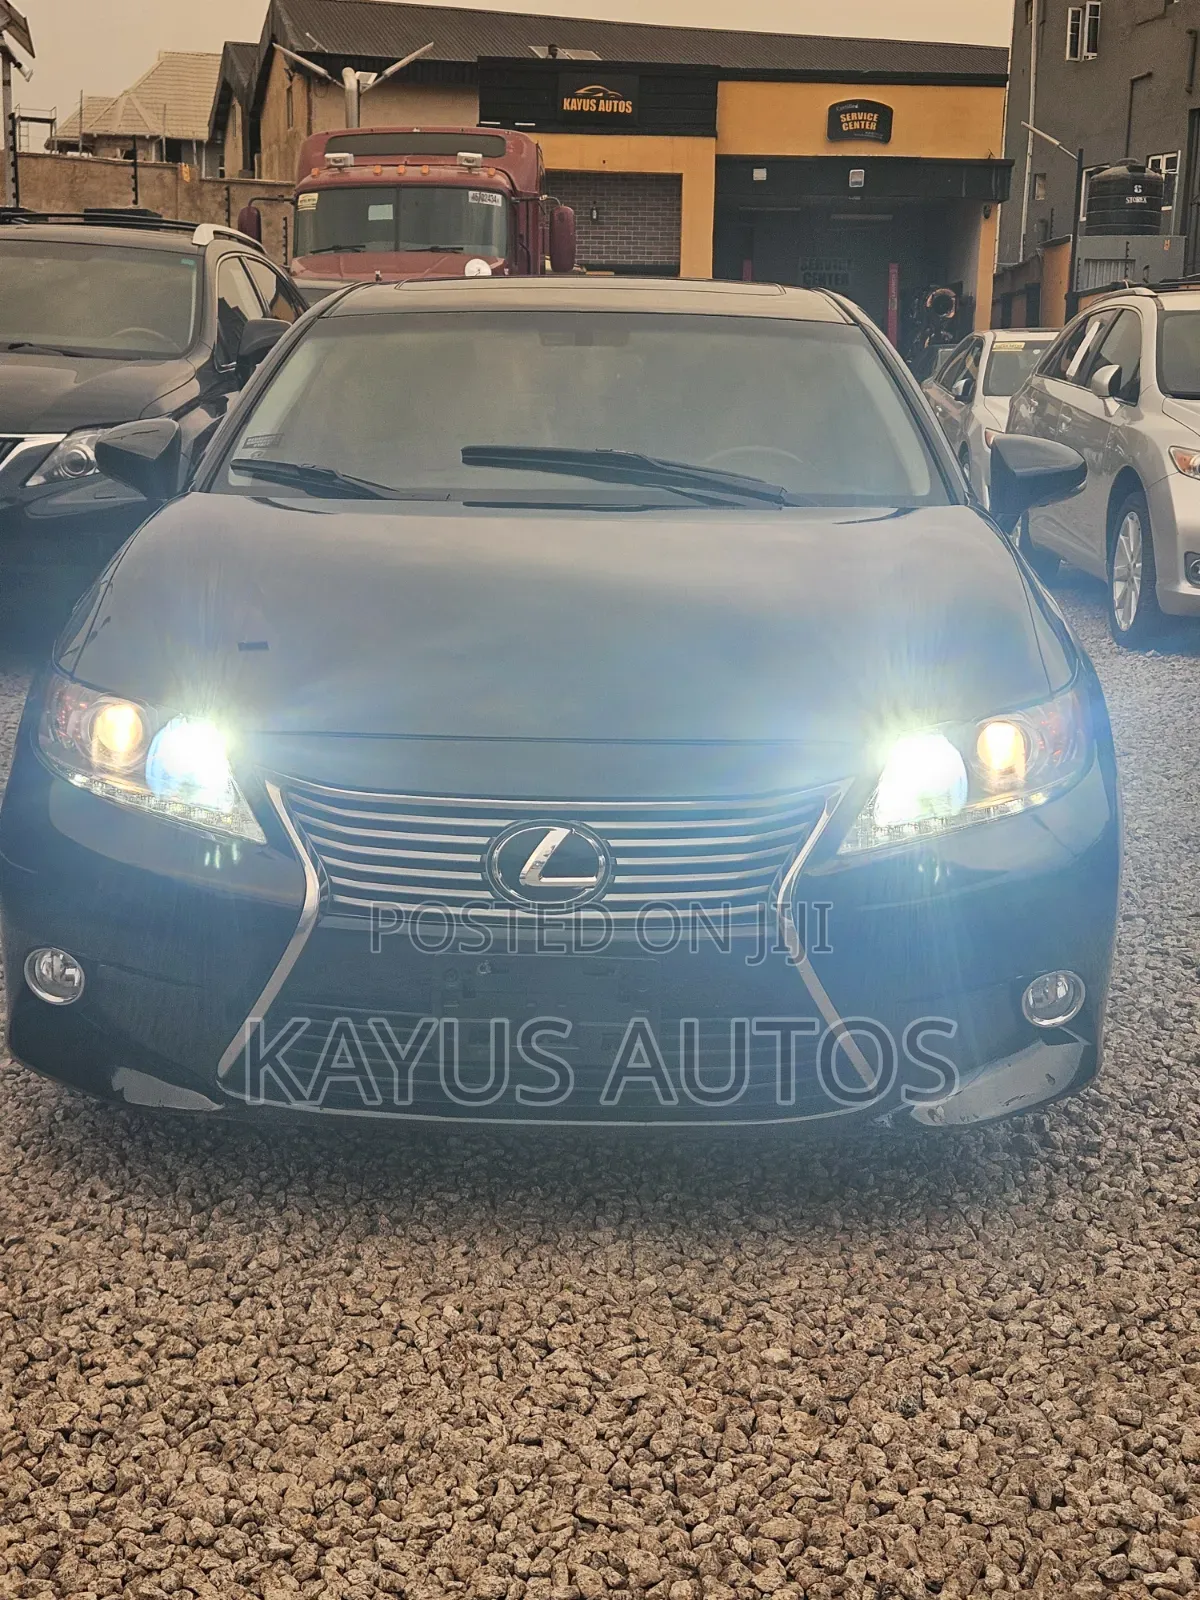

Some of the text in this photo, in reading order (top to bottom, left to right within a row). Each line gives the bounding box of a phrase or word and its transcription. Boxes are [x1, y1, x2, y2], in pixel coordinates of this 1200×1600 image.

[563, 98, 633, 114] KAYUS AUTOS
[840, 111, 879, 122] SERVICE
[842, 121, 877, 131] CENTER
[803, 272, 850, 286] CENTER
